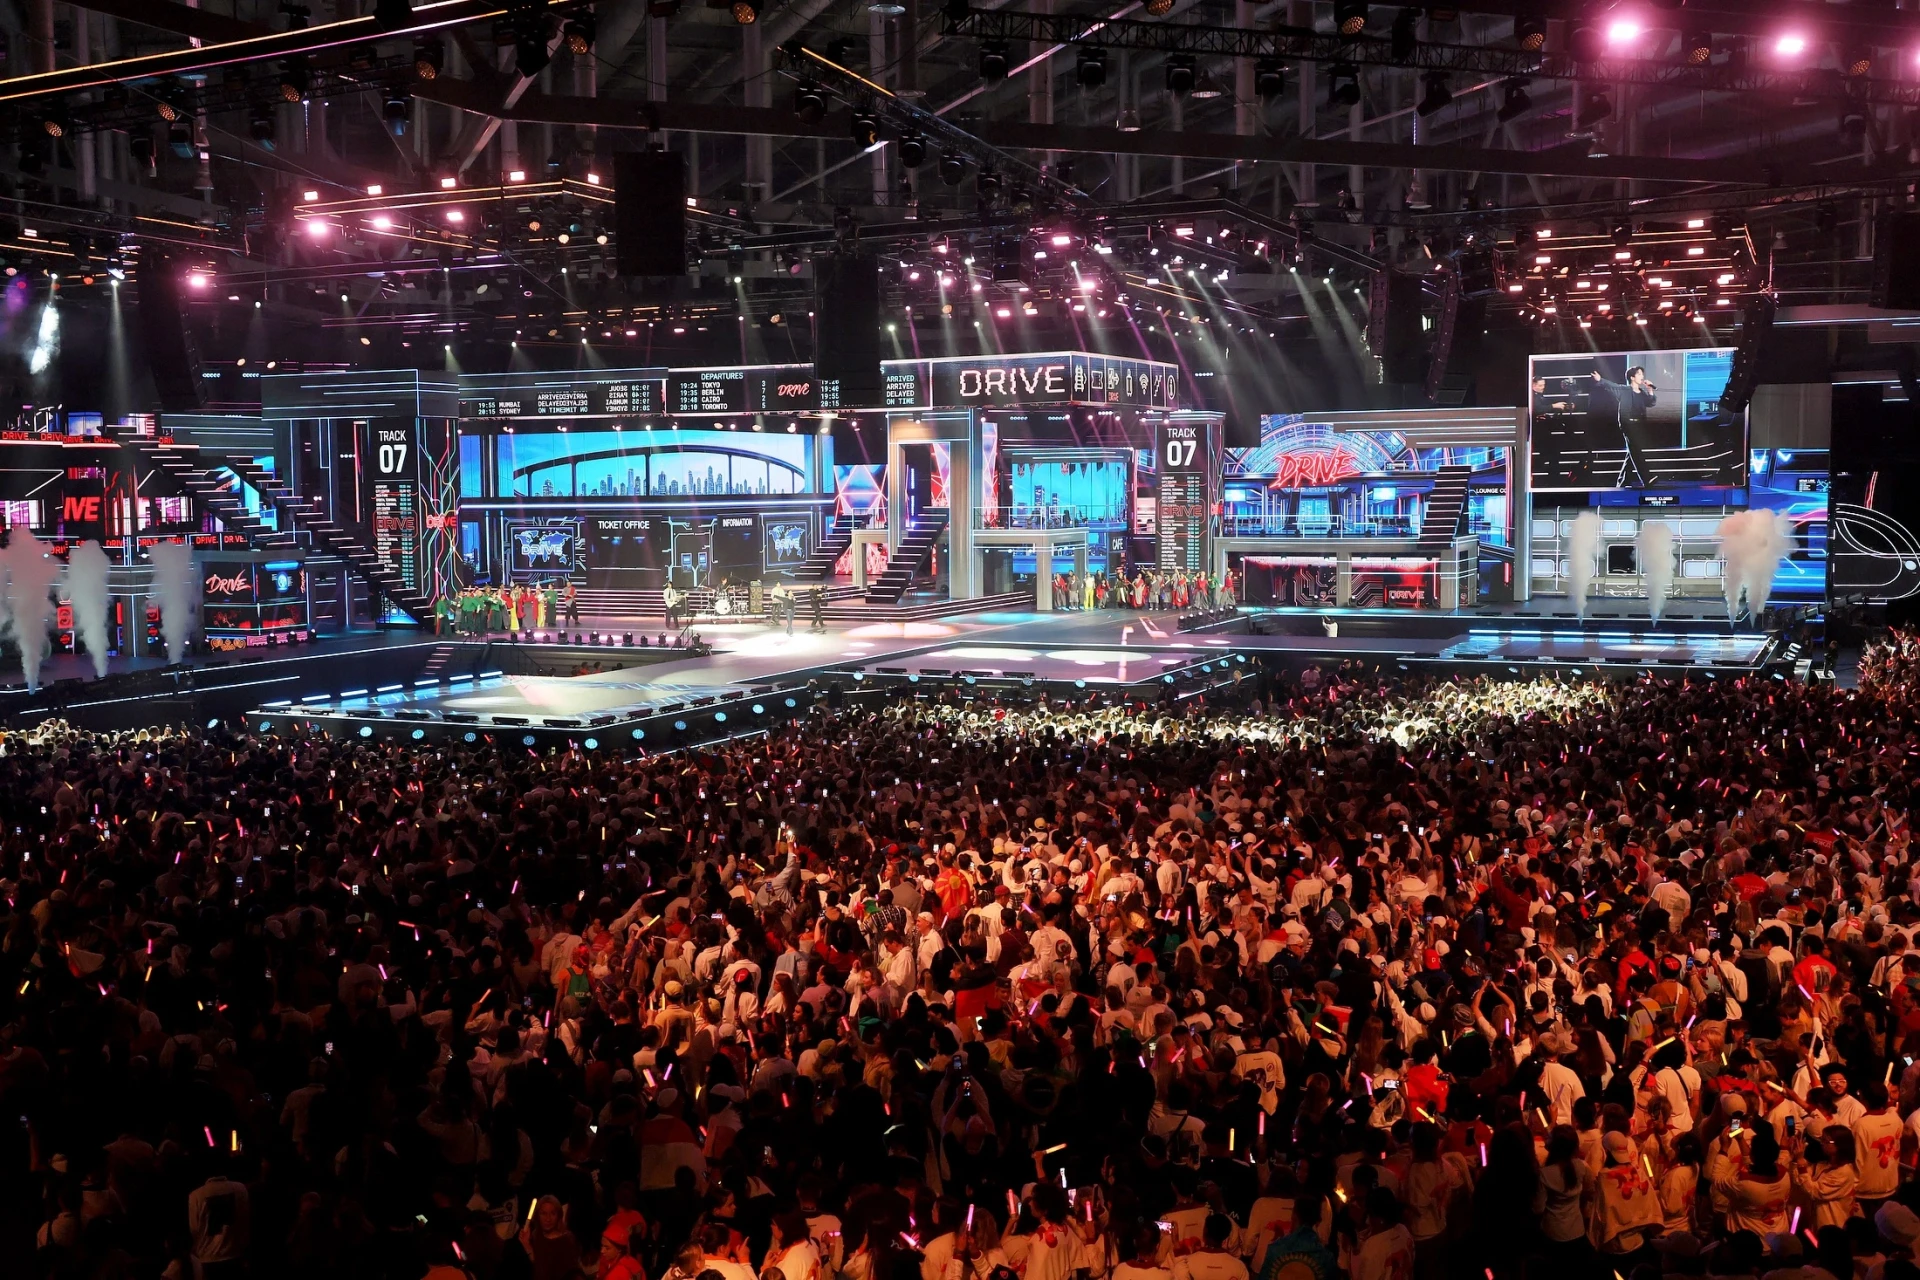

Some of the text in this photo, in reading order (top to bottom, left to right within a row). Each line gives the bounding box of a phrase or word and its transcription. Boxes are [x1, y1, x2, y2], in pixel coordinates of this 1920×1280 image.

[701, 372, 744, 380] DEPARTURES
[960, 366, 1066, 397] DRIVE
[777, 383, 810, 397] DRIVE
[378, 429, 407, 441] TRACK
[1167, 427, 1197, 438] TRACK
[379, 444, 408, 474] 07
[1166, 440, 1197, 467] 07
[1268, 443, 1361, 488] DRIVE
[1161, 505, 1203, 517] DRIVE
[375, 516, 415, 531] DRIVE
[598, 520, 650, 530] TICKET OFFICE
[722, 518, 753, 527] INFORMATION
[521, 543, 563, 555] DRIVE
[1112, 538, 1124, 550] CAFE
[205, 568, 252, 596] DRIVE
[1388, 590, 1425, 599] DRIVE
